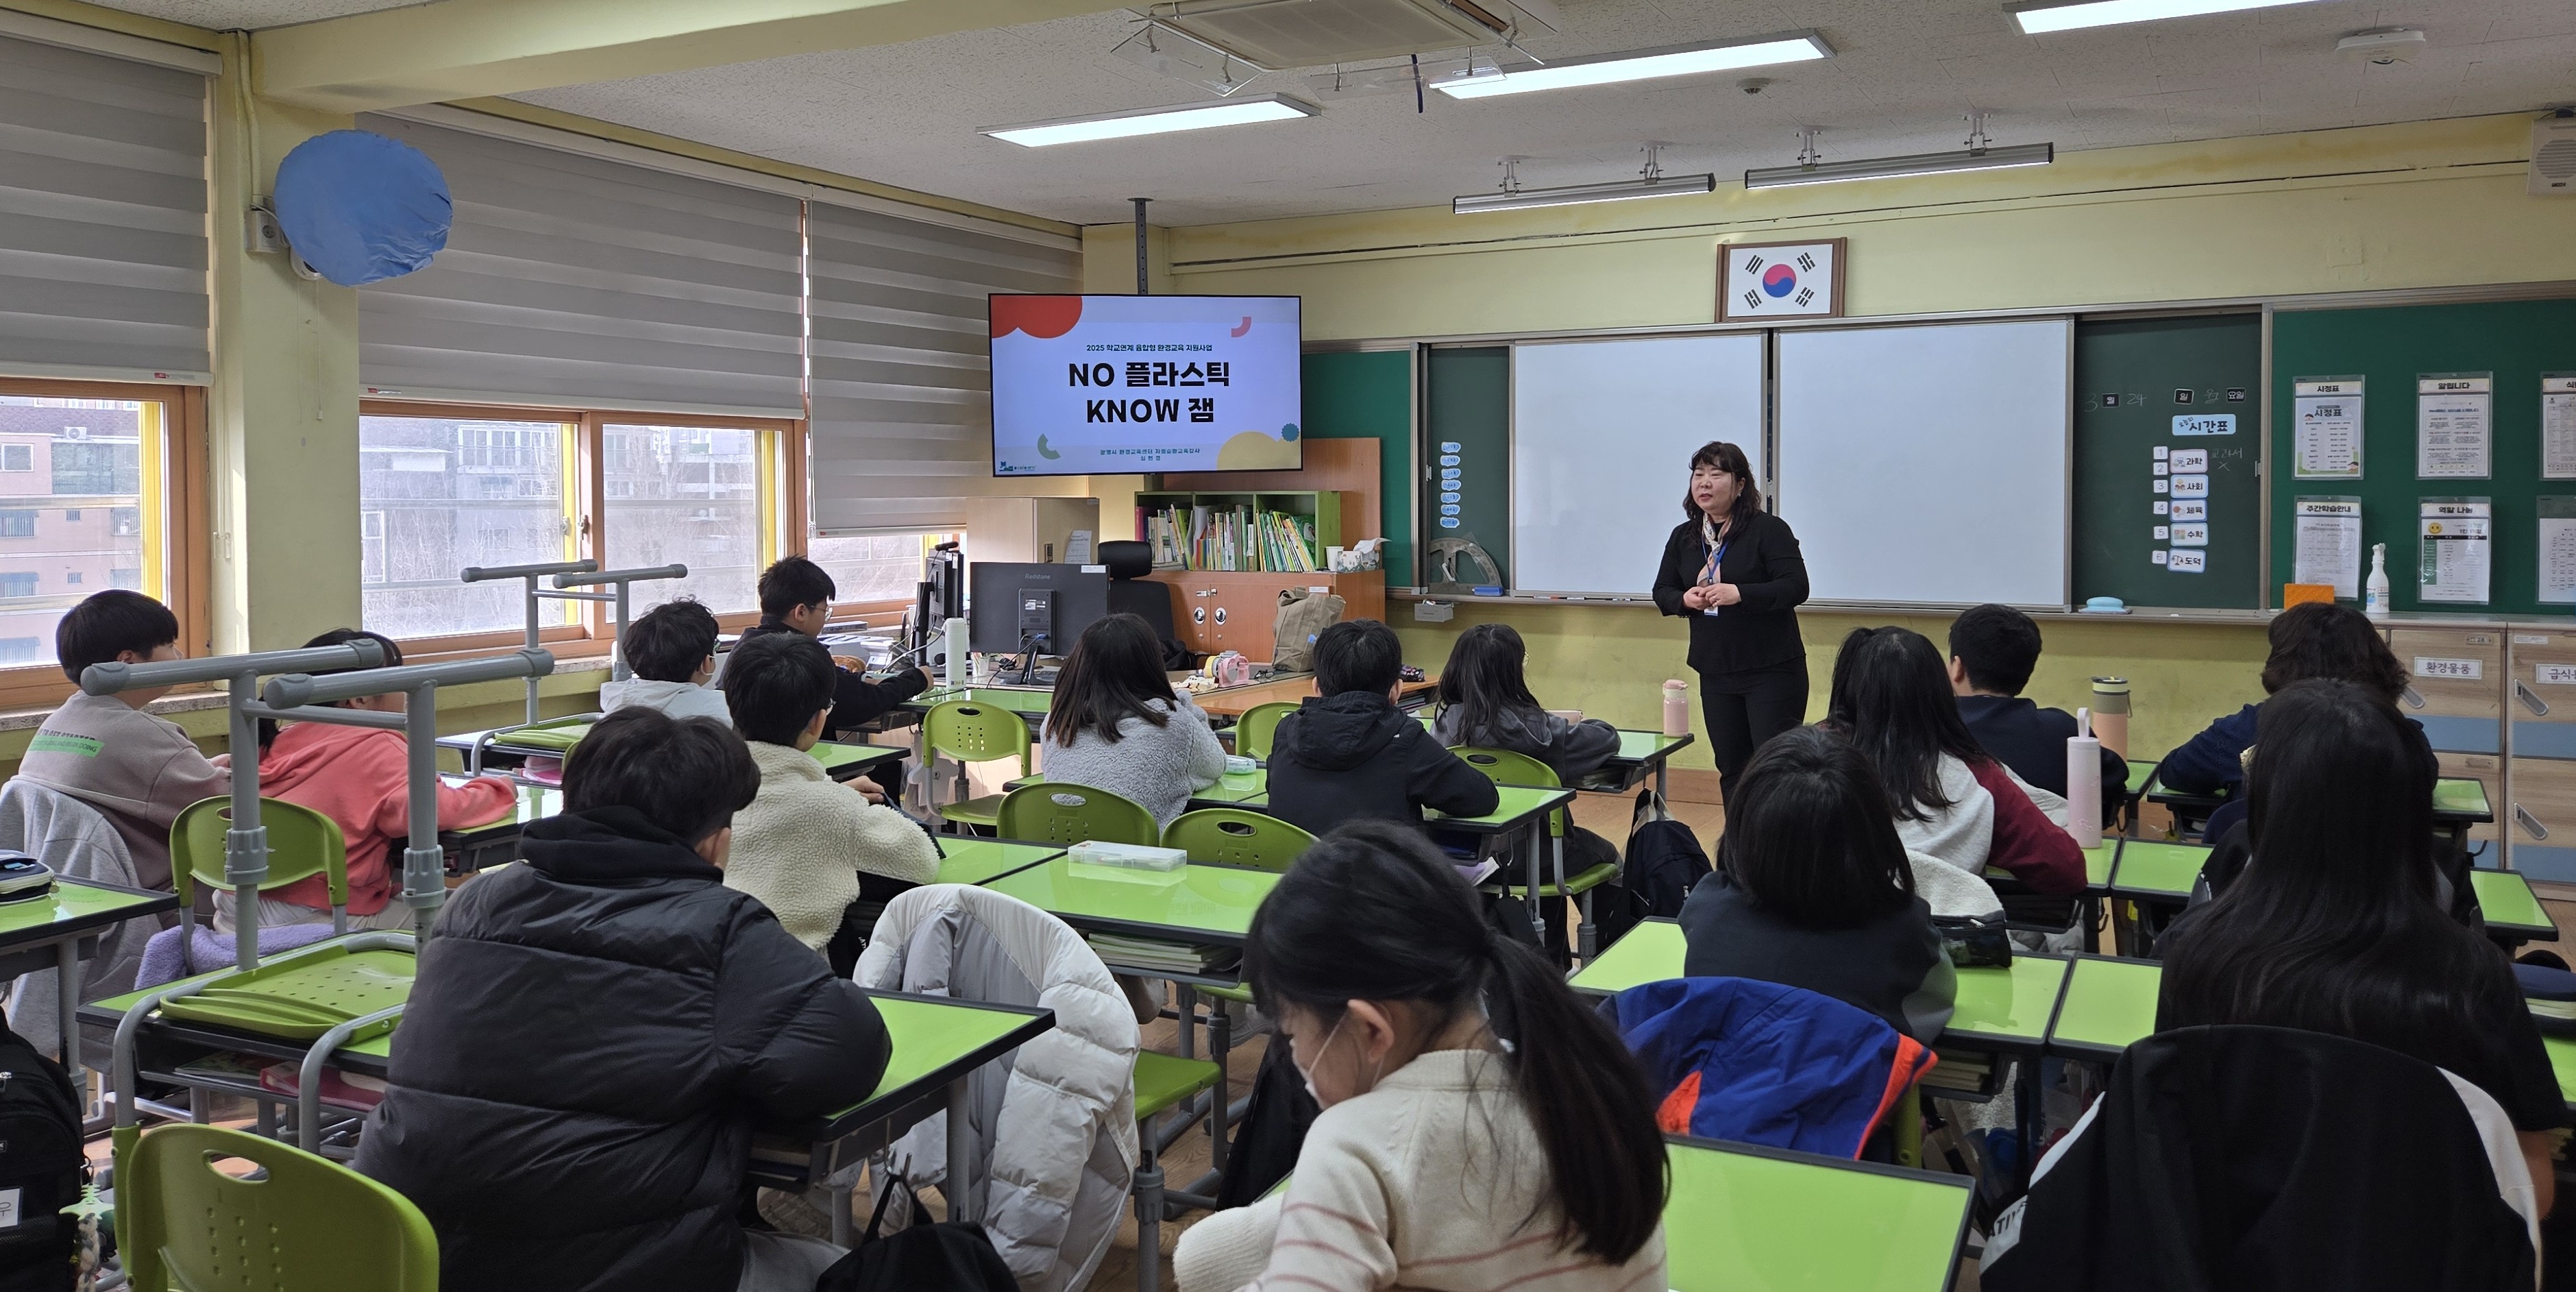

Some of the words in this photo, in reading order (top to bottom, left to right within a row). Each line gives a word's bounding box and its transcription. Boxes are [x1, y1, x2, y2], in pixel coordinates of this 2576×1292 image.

[1069, 363, 1115, 387] NO
[1126, 362, 1229, 387] 플라스틱
[2126, 393, 2148, 406] 24
[1087, 399, 1179, 423] KNOW
[1188, 398, 1214, 423] 잼
[2189, 421, 2227, 433] 시간표
[2186, 457, 2203, 465] 과학
[2185, 557, 2200, 565] 도덕
[2426, 661, 2470, 674] 환경물품
[79, 743, 98, 753] DOING
